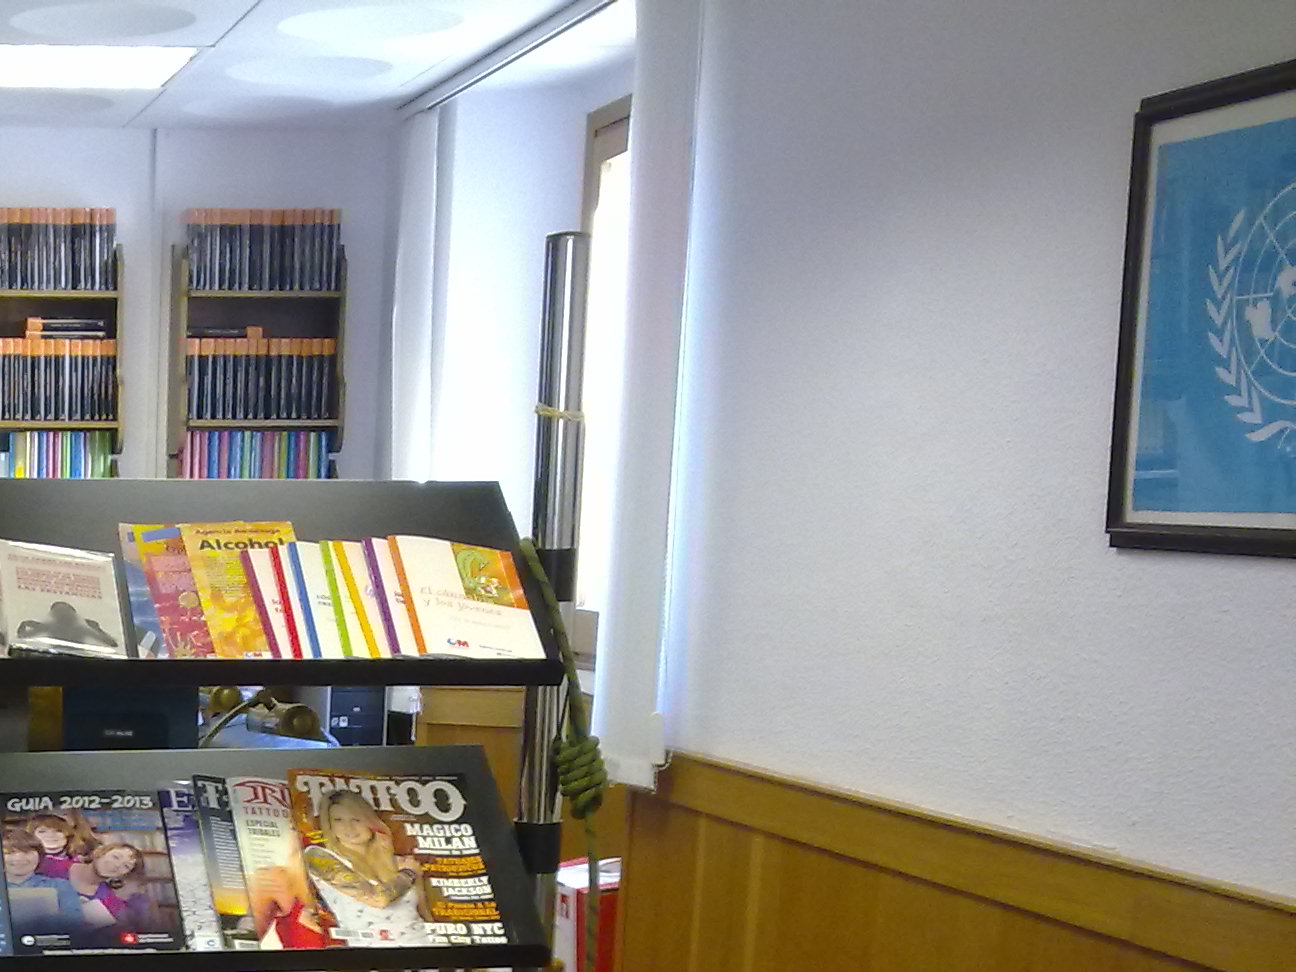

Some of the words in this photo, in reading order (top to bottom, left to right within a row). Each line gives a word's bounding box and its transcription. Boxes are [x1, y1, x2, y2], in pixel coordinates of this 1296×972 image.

[199, 537, 284, 551] Alcohol
[6, 796, 54, 812] GUIA
[58, 795, 154, 810] 2012-2013
[404, 822, 473, 837] MAGICO
[416, 835, 478, 850] MILAN
[423, 922, 467, 935] PURO
[470, 922, 505, 935] NYC
